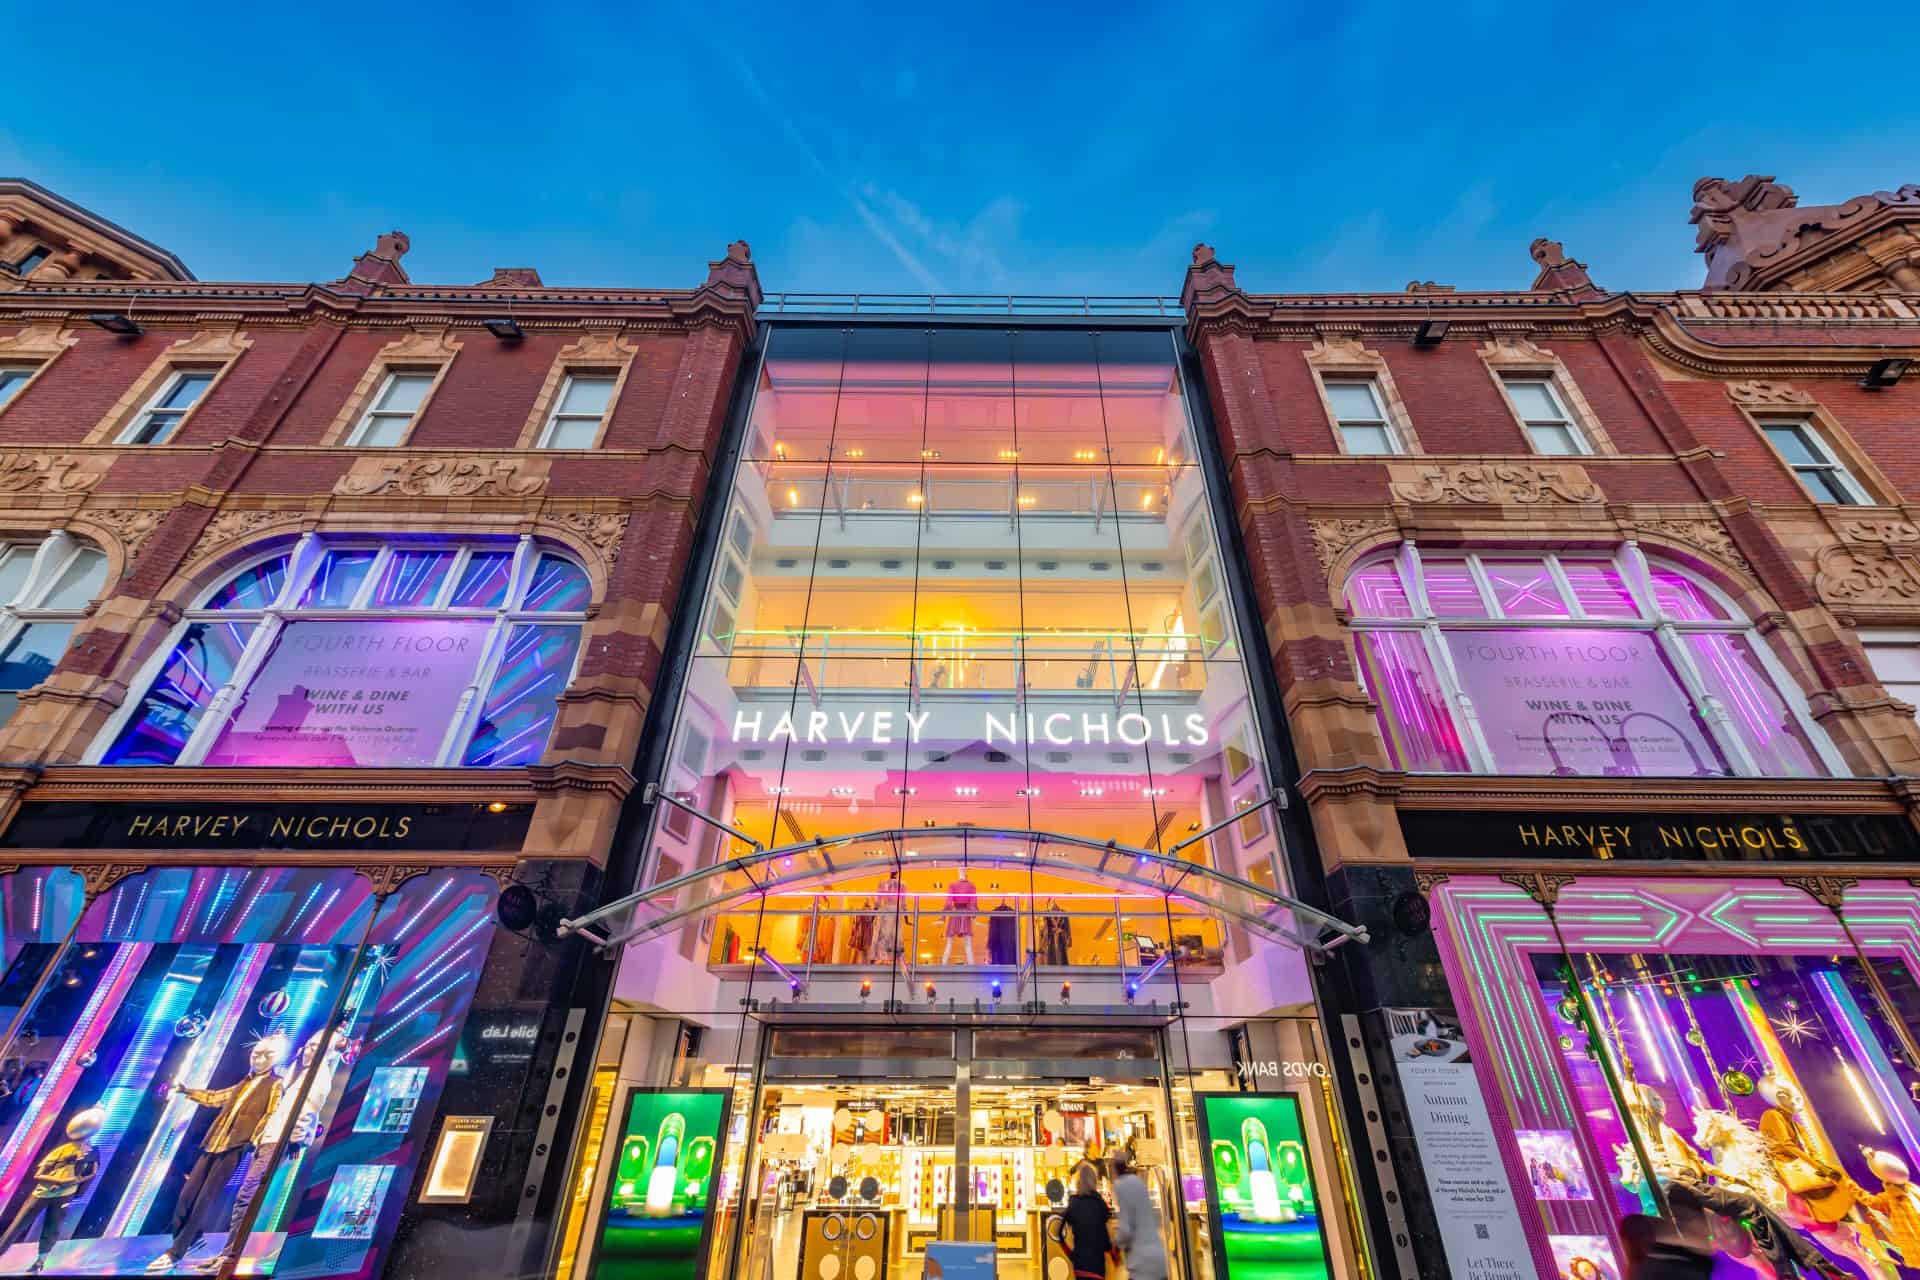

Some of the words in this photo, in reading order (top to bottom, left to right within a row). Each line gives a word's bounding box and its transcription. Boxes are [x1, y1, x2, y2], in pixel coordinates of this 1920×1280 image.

[293, 635, 384, 651] FOURTH
[391, 636, 470, 653] FLOOR
[1464, 645, 1557, 662] FOURTH
[1565, 646, 1640, 663] FLOOR
[303, 664, 381, 678] BRASSERIE
[399, 666, 431, 678] BAR
[1503, 676, 1583, 688] BRASSERIE
[1601, 678, 1633, 689] BAR
[304, 689, 347, 701] WINE
[351, 689, 365, 701] &
[369, 690, 410, 701] DINE
[315, 703, 359, 714] WITH
[363, 704, 385, 714] US
[1526, 700, 1570, 711] WINE
[1577, 701, 1589, 711] &
[1592, 700, 1633, 712] DINE
[1550, 714, 1594, 726] WITH
[1601, 715, 1622, 726] US
[731, 710, 931, 744] HARVEY
[984, 713, 1210, 746] NICHOLS
[128, 815, 249, 837] HARVEY
[270, 816, 413, 838] NICHOLS
[1519, 824, 1632, 848] HARVEY
[1659, 826, 1804, 849] NICHOLS
[1423, 1093, 1469, 1106] Autumn
[1430, 1110, 1471, 1127] Dining
[1466, 1257, 1483, 1270] Let
[1484, 1257, 1515, 1270] There
